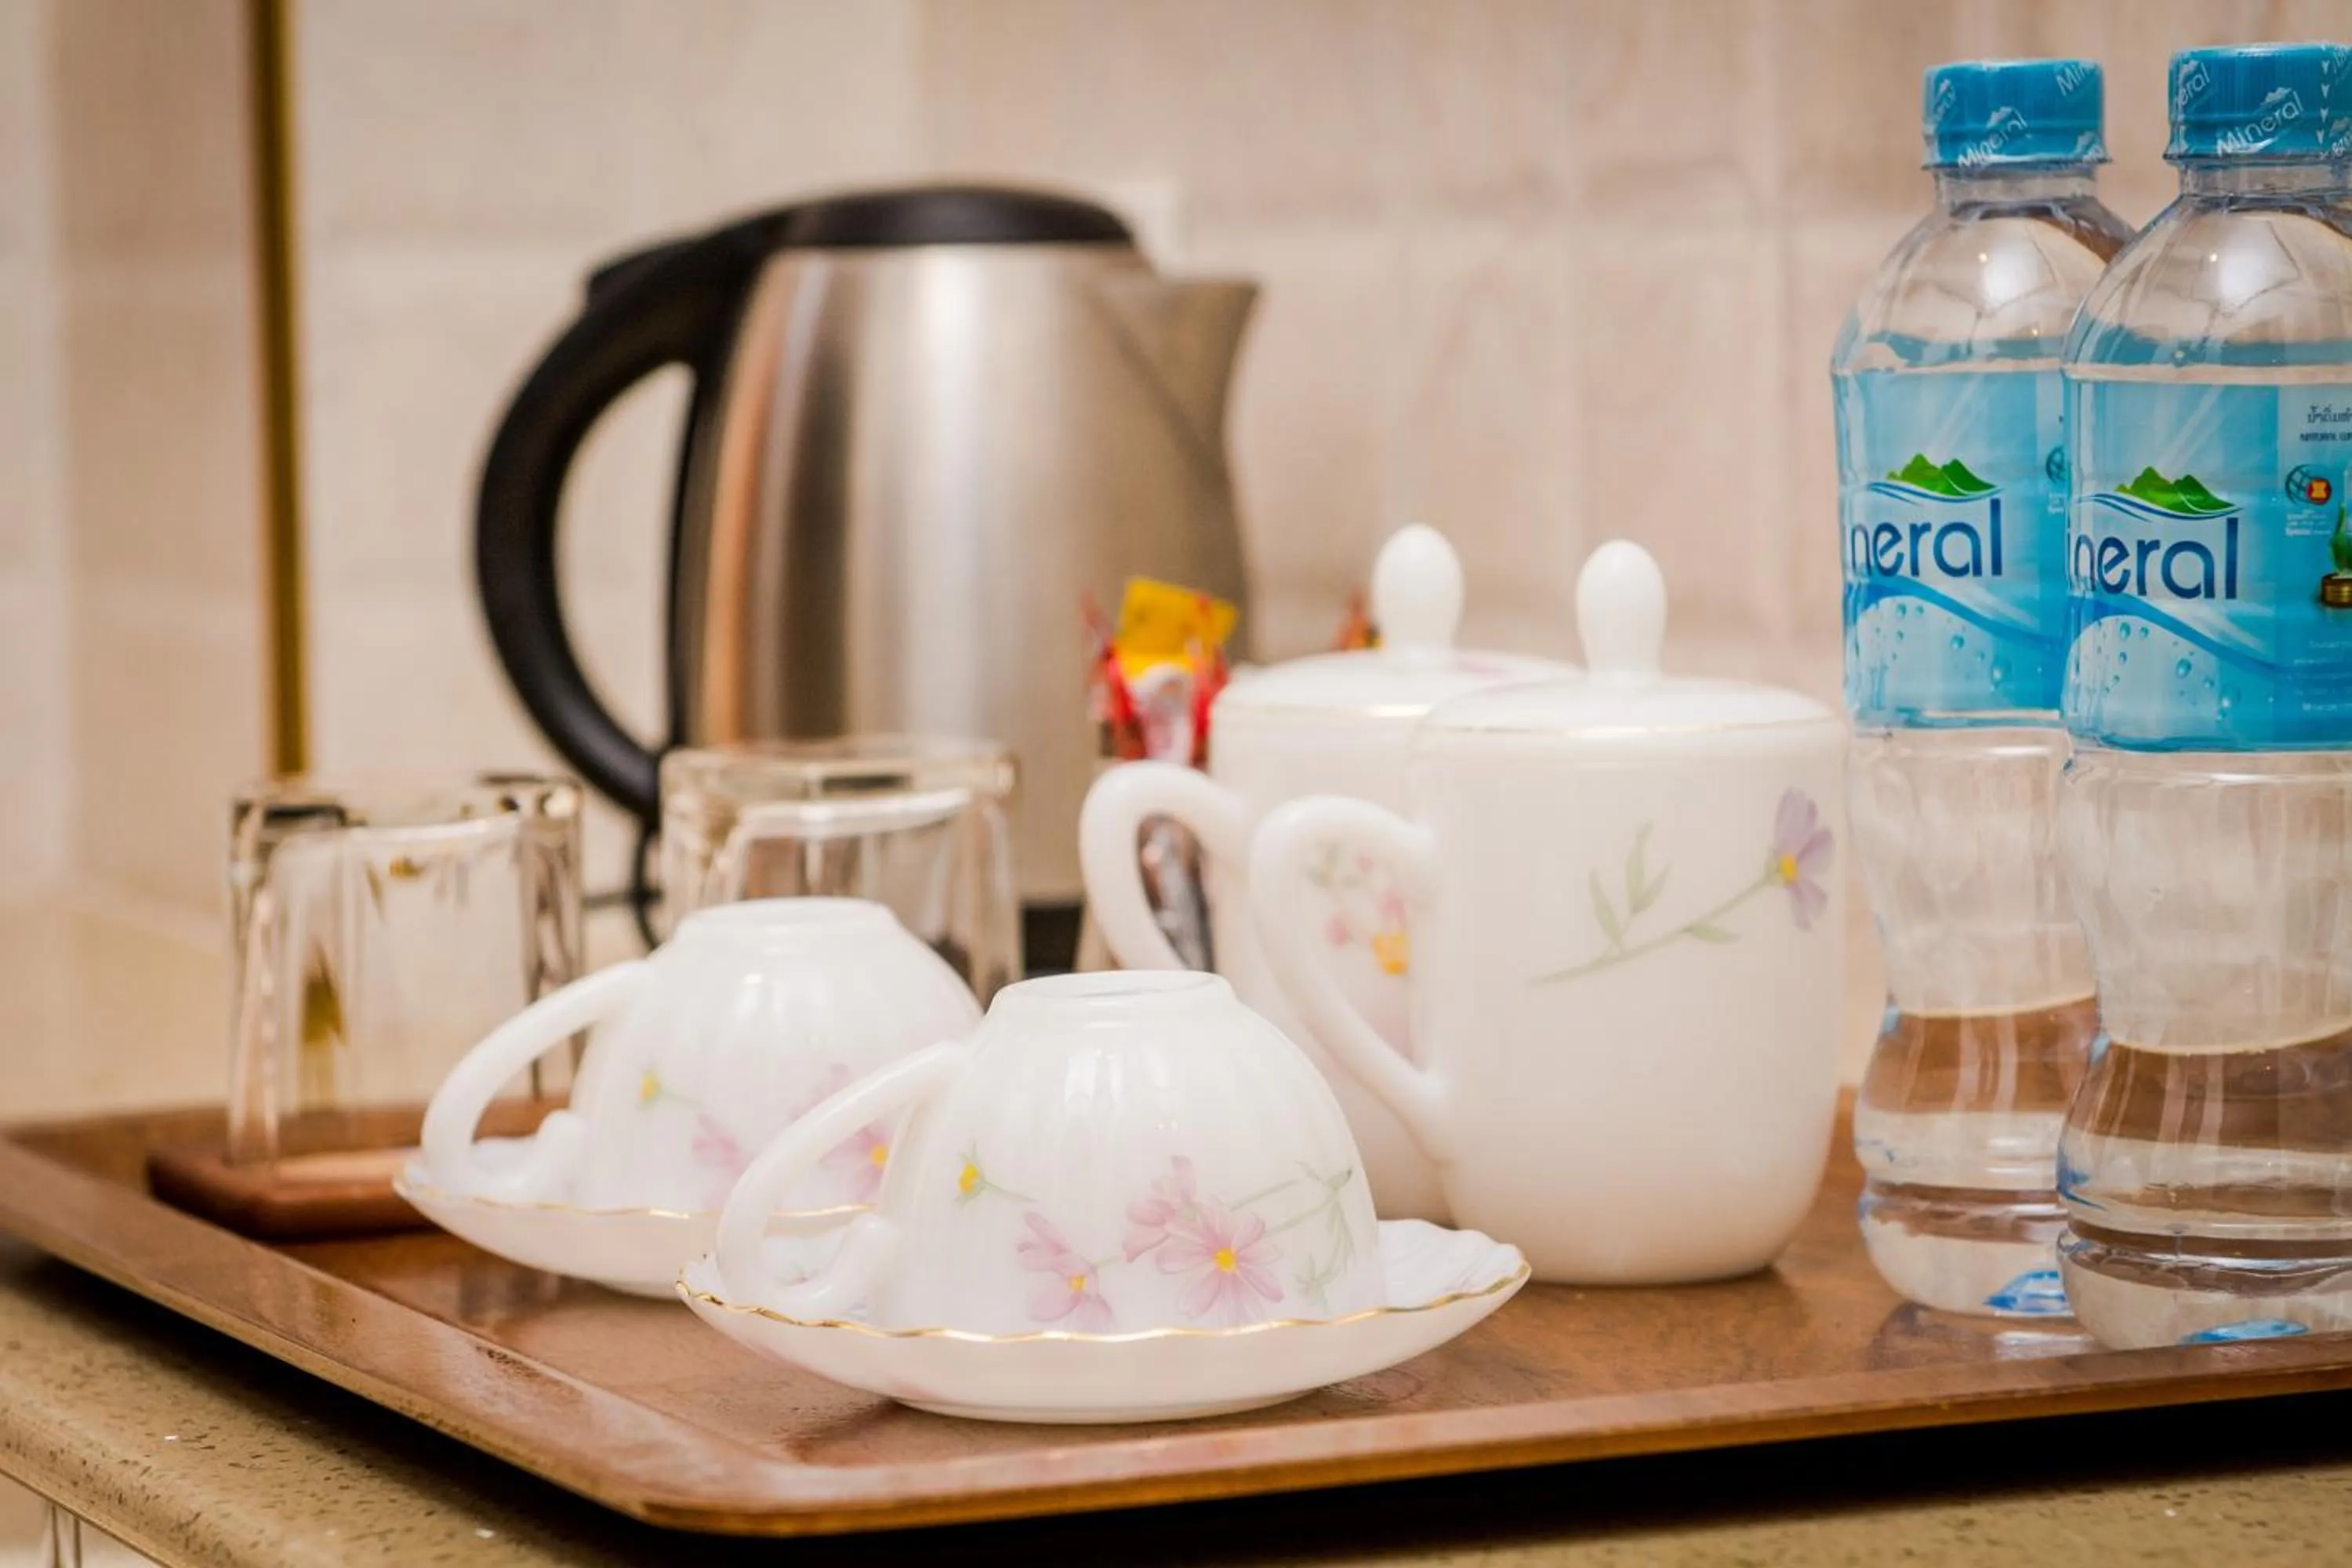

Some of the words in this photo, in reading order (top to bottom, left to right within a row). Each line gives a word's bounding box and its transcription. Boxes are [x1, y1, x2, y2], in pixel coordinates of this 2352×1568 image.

[1958, 108, 2029, 168] Mineral
[2217, 90, 2304, 156] Mineral
[1851, 498, 2003, 578] neral
